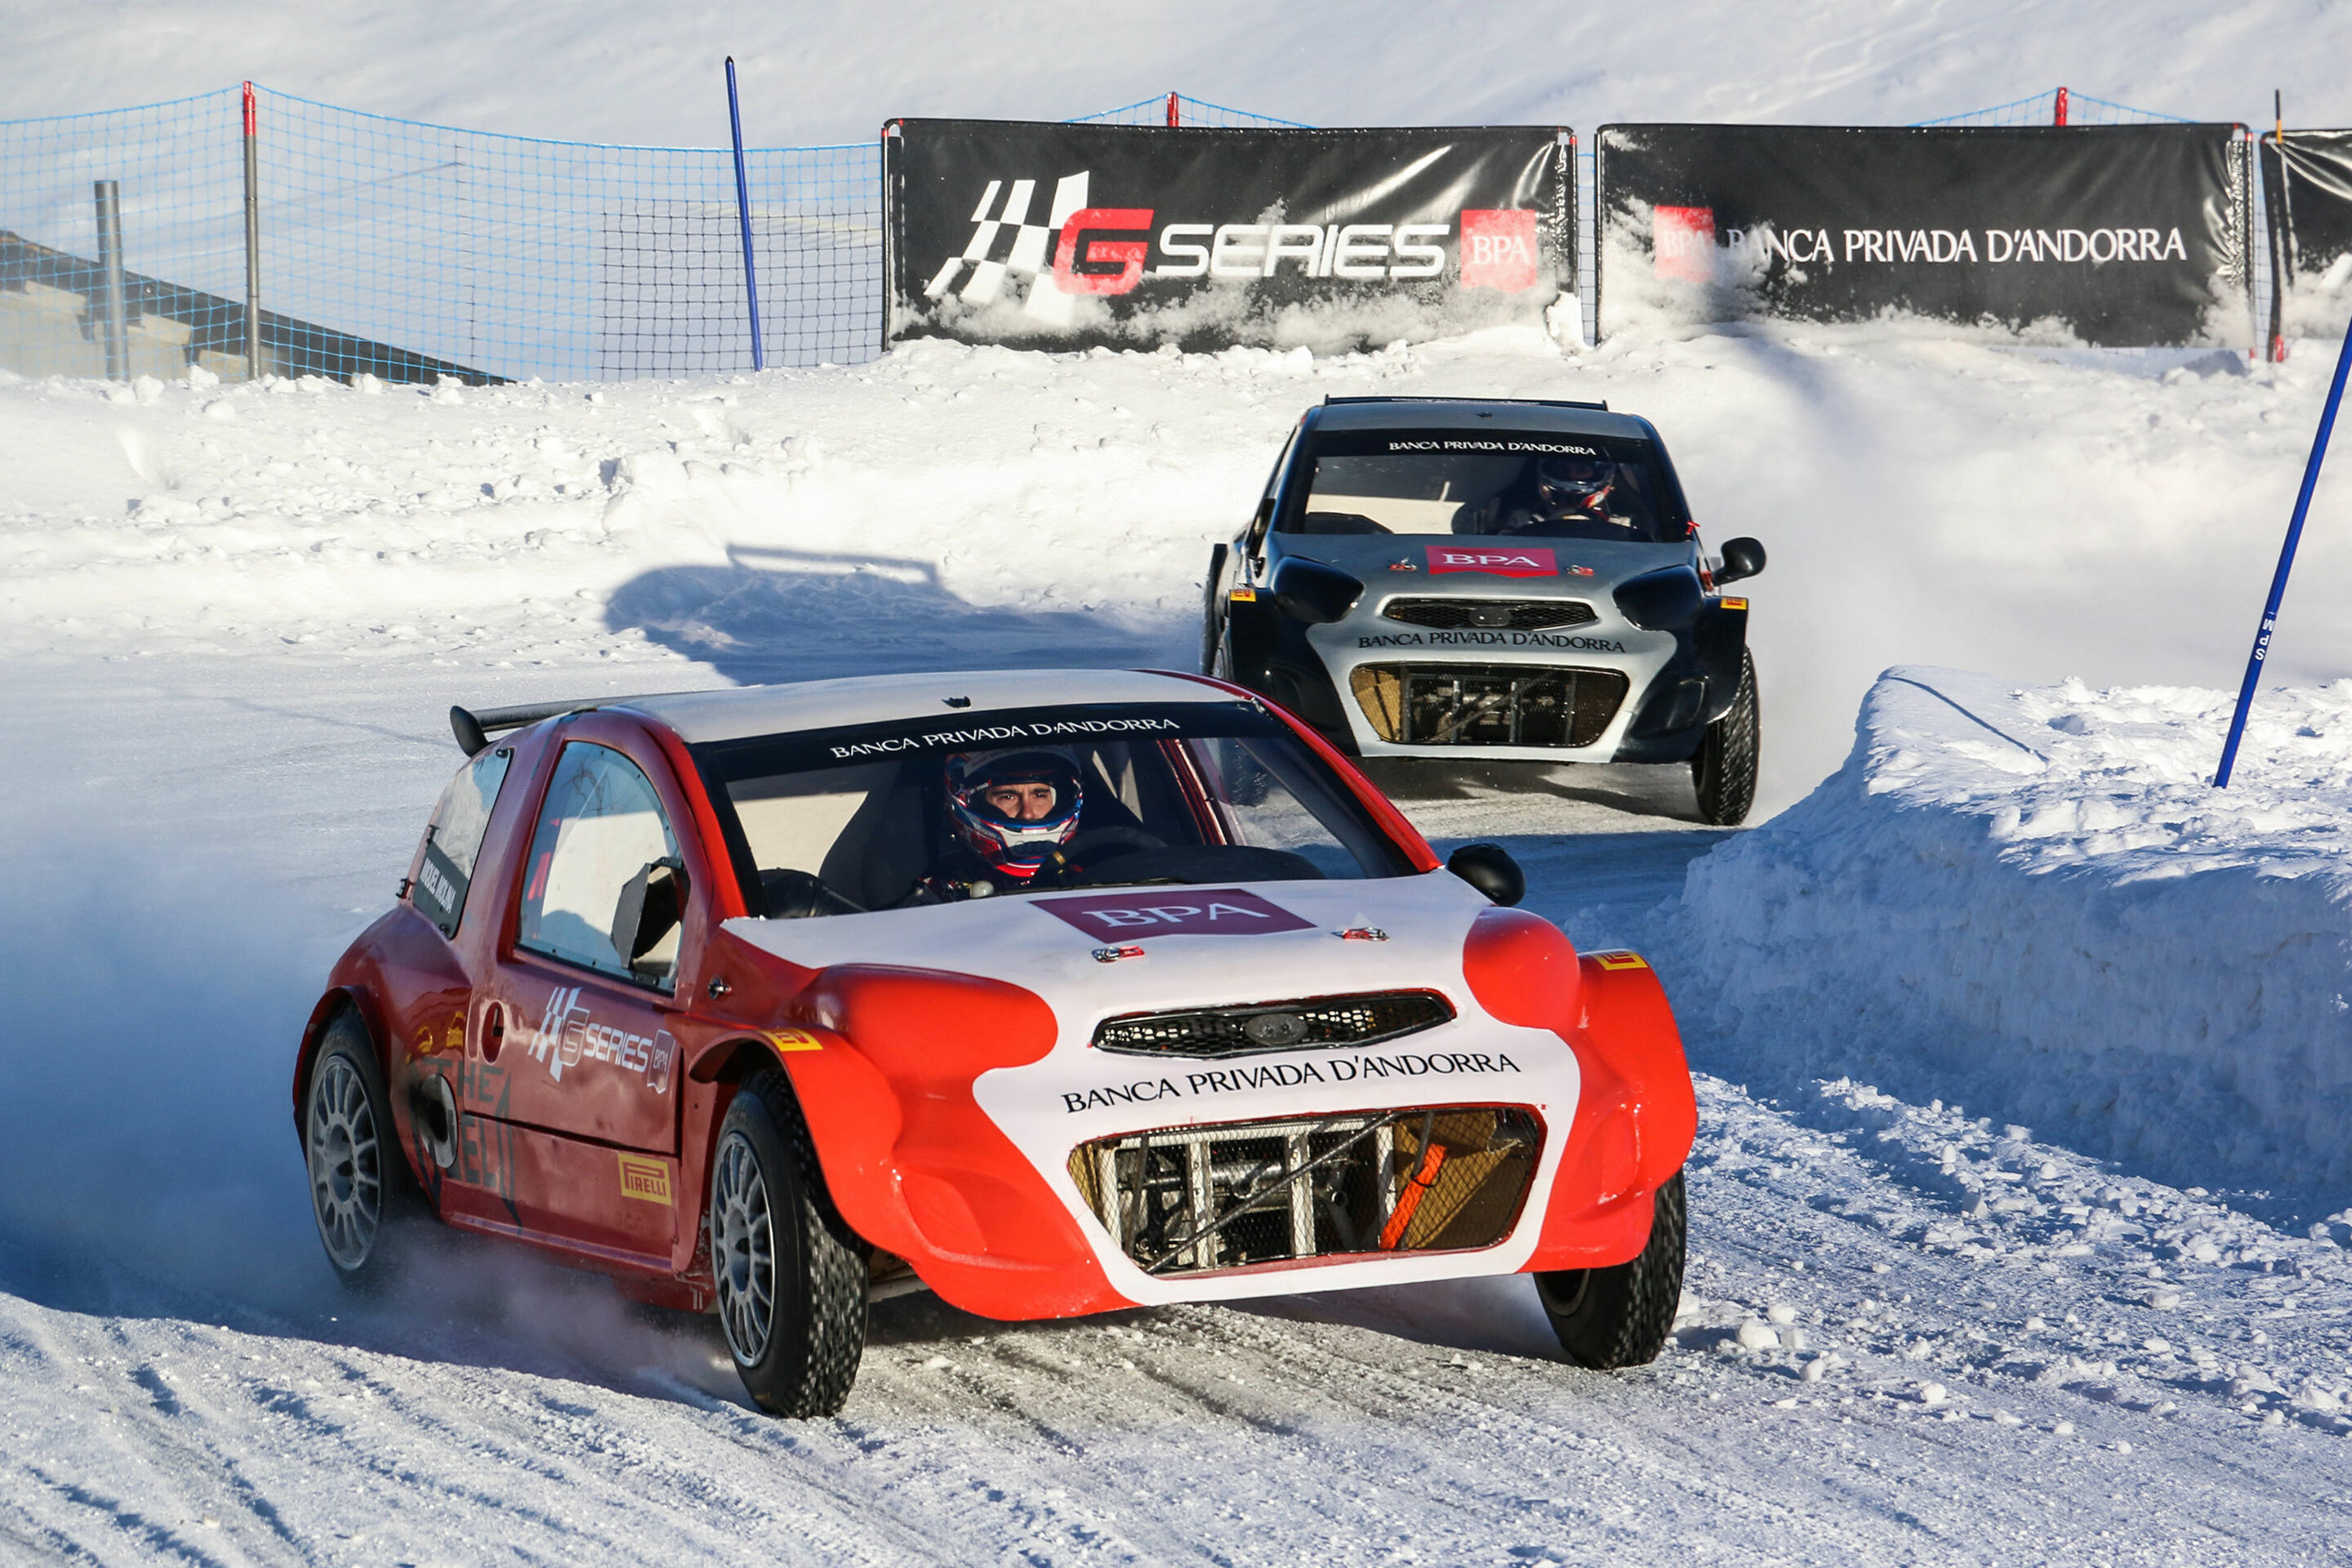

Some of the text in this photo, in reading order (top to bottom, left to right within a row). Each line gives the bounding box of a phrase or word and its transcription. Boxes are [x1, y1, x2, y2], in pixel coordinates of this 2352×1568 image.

[1156, 224, 1450, 278] SERIES
[1472, 234, 1531, 265] BPA
[1843, 228, 1978, 263] PRIVADA
[1985, 225, 2187, 263] D'ANDORRA
[1389, 441, 1597, 456] BANCA PRIVADA D'ANDORRA
[1441, 554, 1541, 568] BPA
[1358, 631, 1626, 653] BANCA PRIVADA D'ANDORRA
[830, 737, 920, 759] BANCA
[922, 724, 1028, 746] PRIVADA
[1081, 902, 1271, 928] BPA
[583, 1022, 653, 1073] SERIES
[653, 1048, 669, 1072] BPA
[1061, 1053, 1522, 1114] BANCA PRIVADA D'ANDORRA
[622, 1161, 667, 1197] PIRELLI
